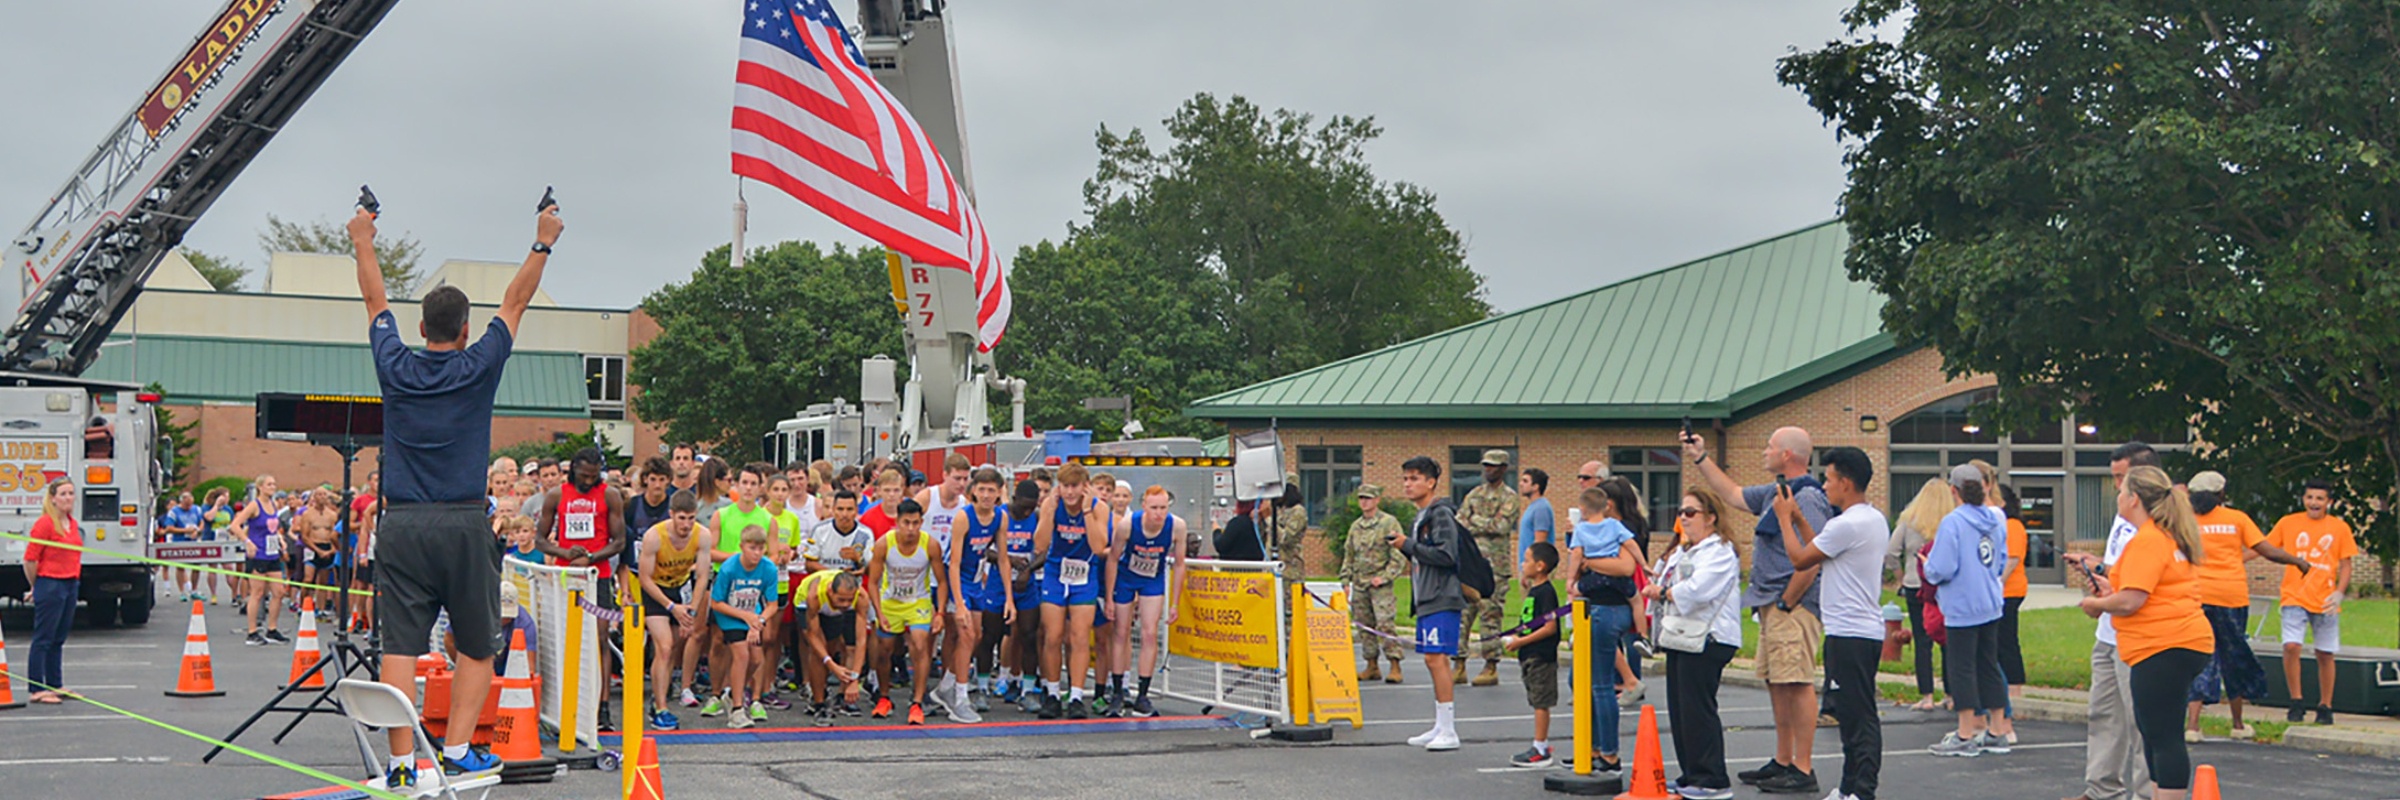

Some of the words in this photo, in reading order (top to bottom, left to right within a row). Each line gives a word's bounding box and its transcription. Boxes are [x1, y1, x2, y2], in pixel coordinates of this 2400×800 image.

[0, 463, 46, 492] 85
[161, 549, 201, 557] STATION
[1310, 628, 1346, 640] STRIDERS
[1421, 627, 1439, 647] 14
